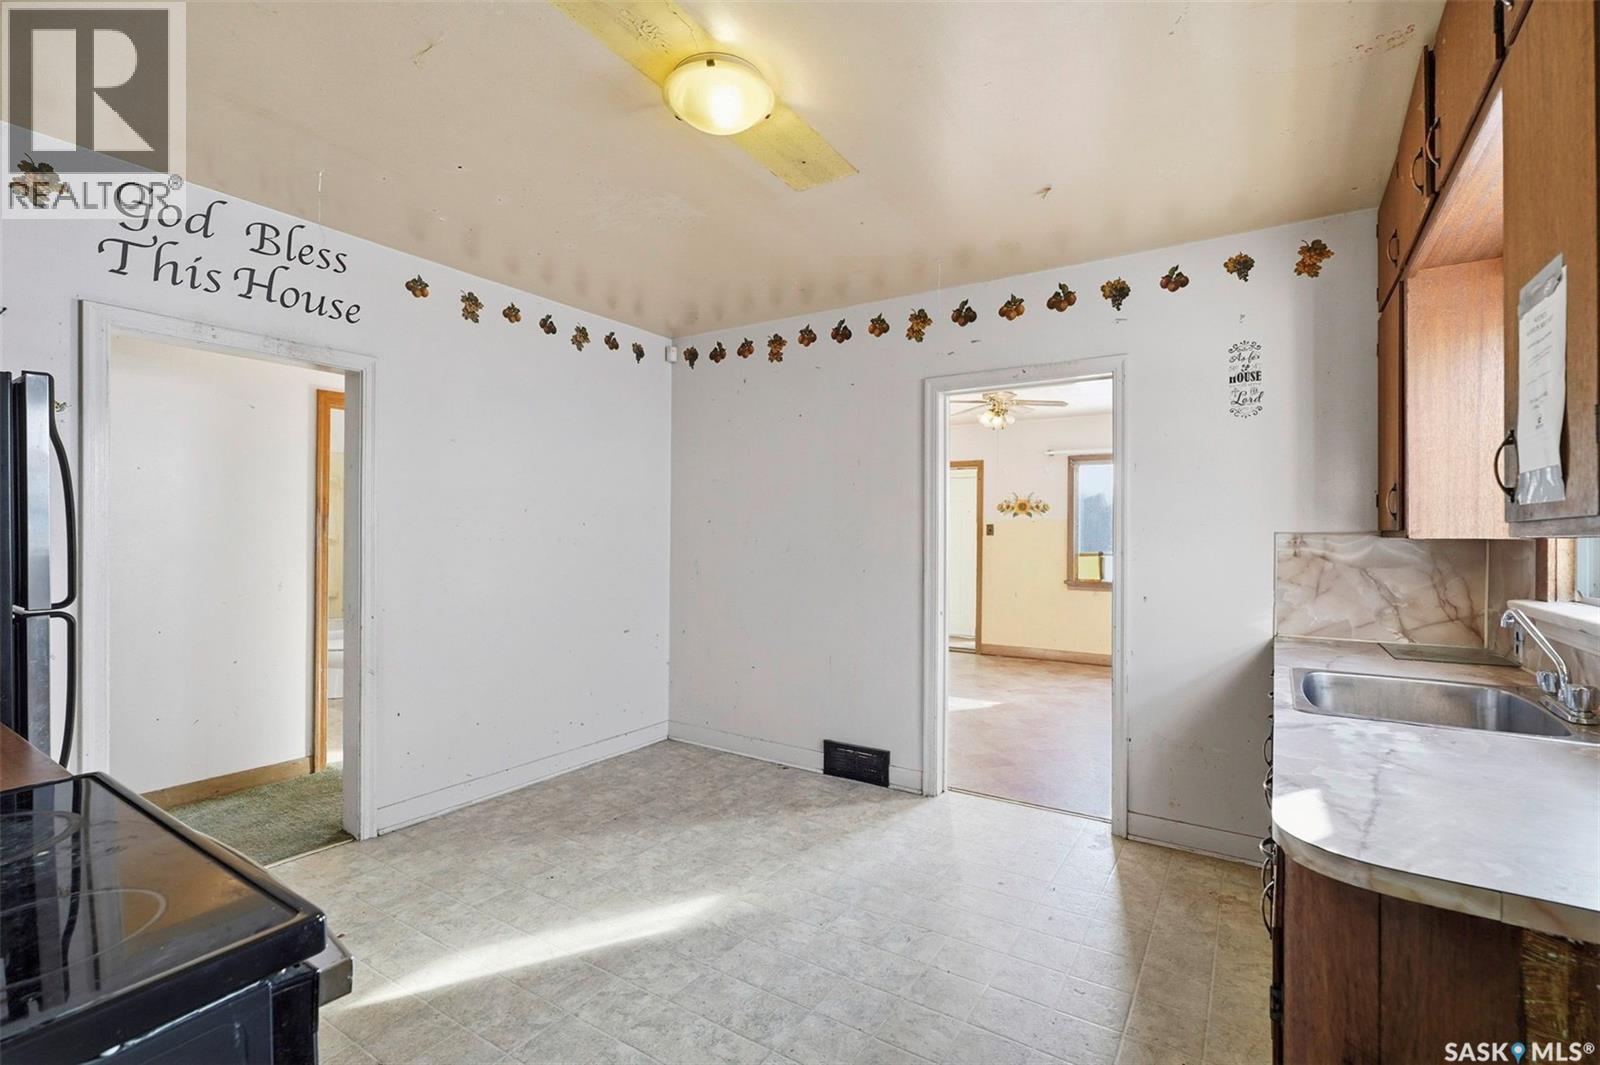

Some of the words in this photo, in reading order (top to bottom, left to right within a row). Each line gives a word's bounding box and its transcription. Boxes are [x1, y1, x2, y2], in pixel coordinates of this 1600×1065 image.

[113, 181, 227, 239] God
[245, 222, 347, 273] Bless
[98, 236, 222, 293] This
[234, 266, 361, 324] House
[1230, 391, 1264, 406] Lord
